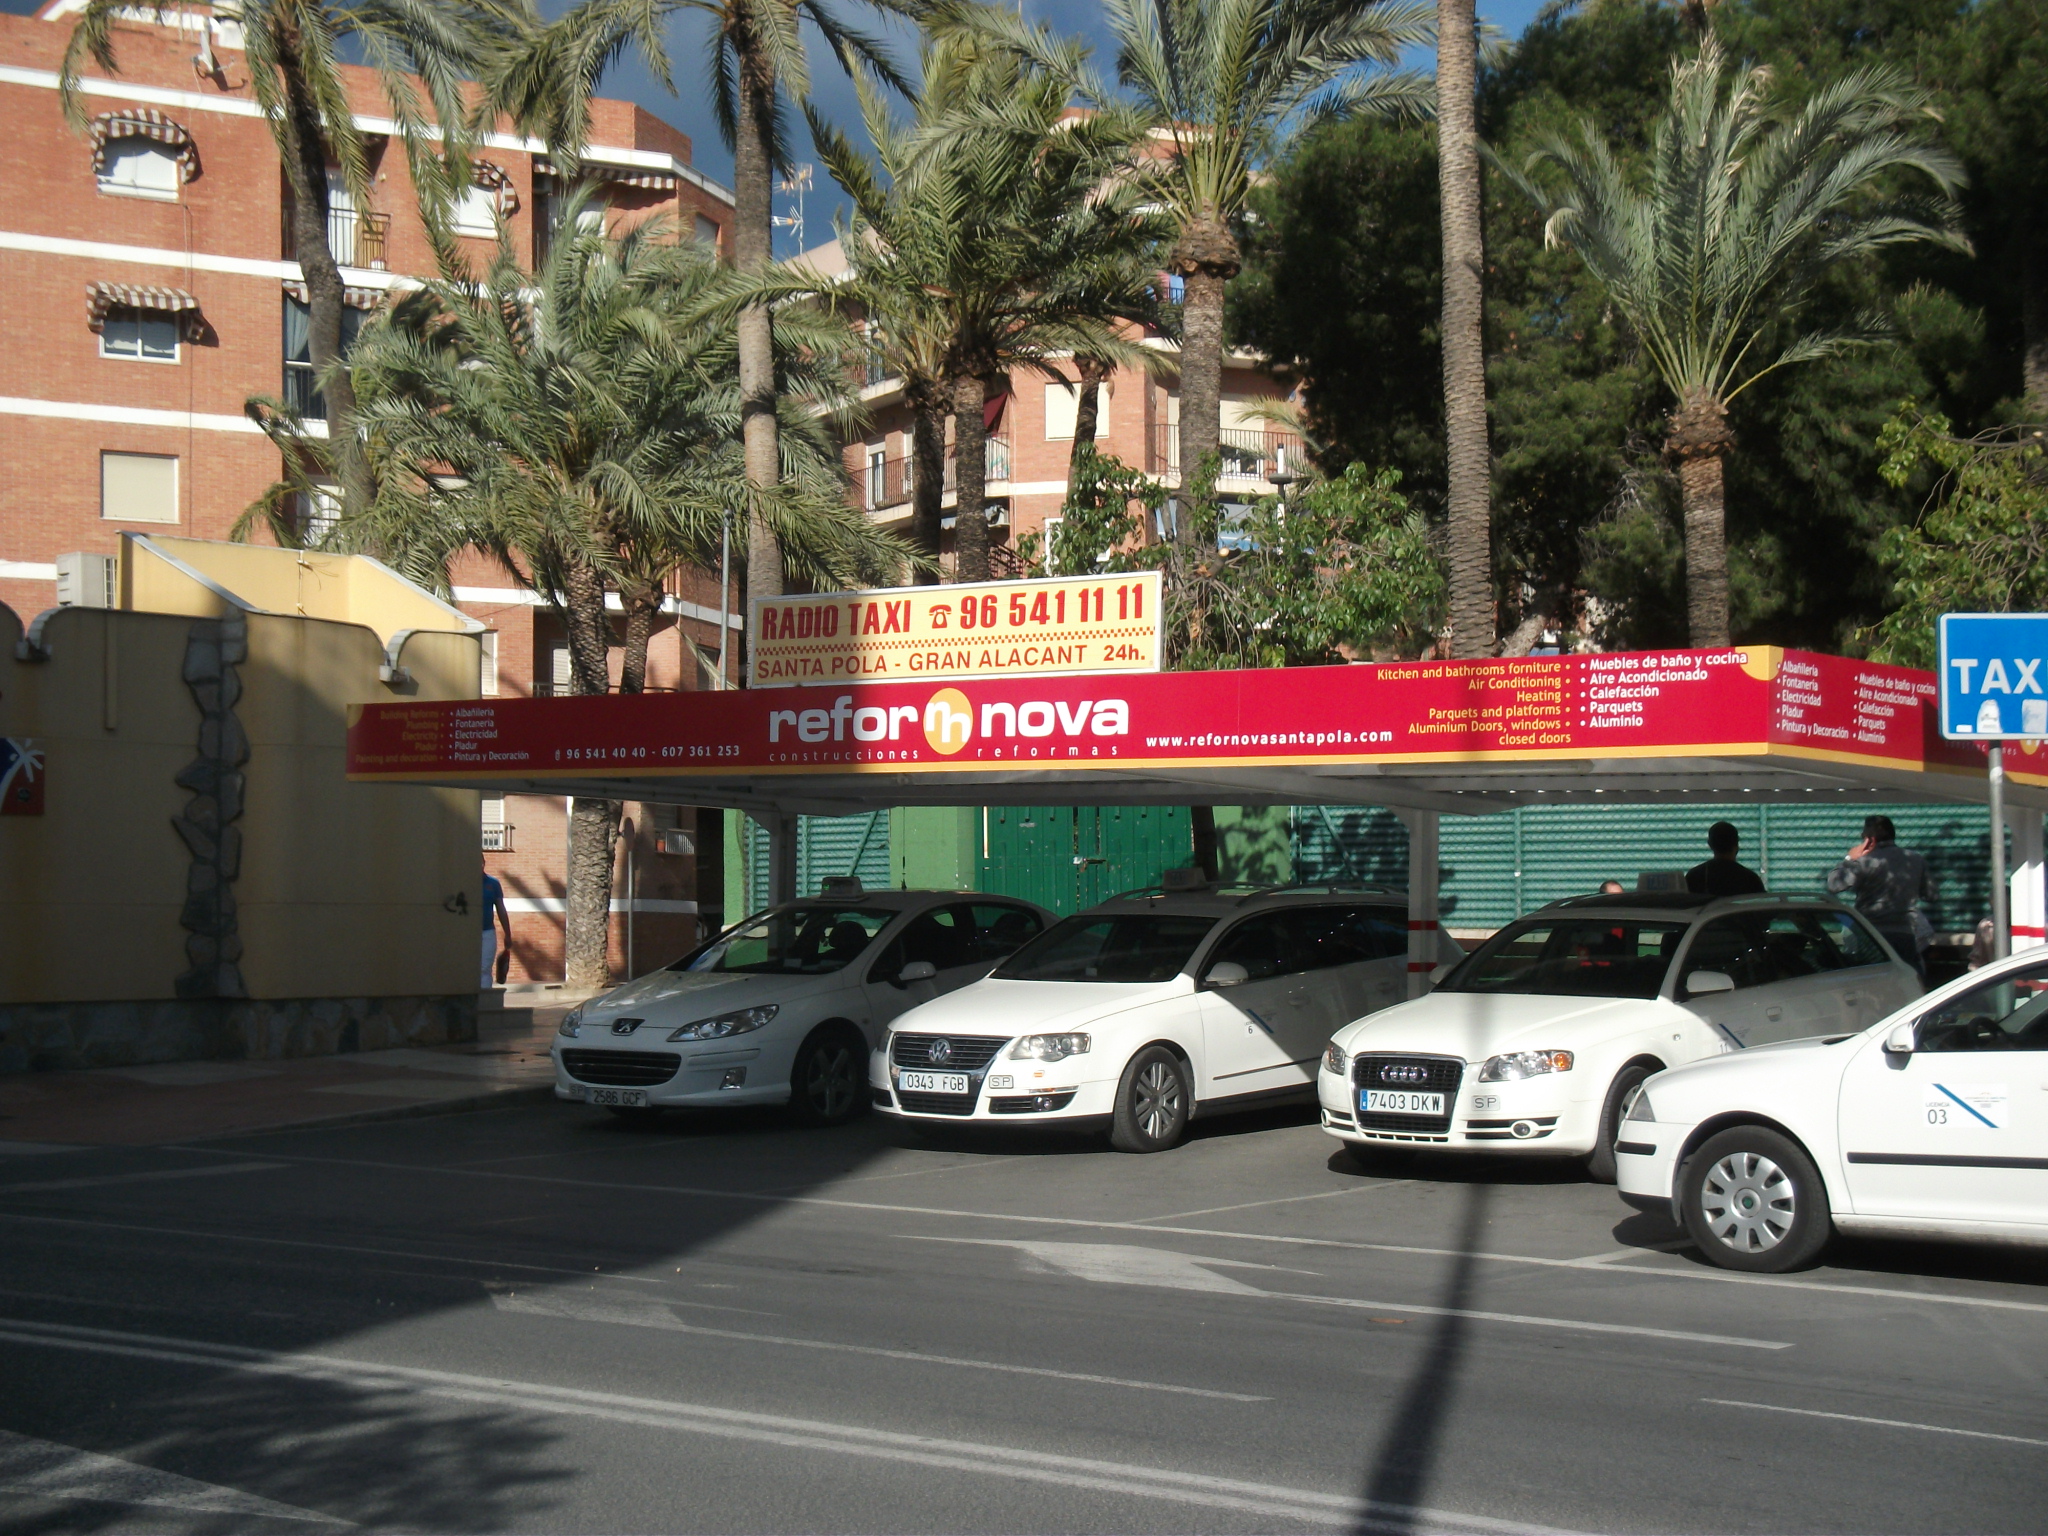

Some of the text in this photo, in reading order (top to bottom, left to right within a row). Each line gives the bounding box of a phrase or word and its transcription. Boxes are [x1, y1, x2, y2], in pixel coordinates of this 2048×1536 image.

[762, 583, 1143, 641] RADIO TAXI 96 541 11 11
[758, 658, 824, 678] SANTA
[831, 655, 887, 675] POLA
[909, 651, 970, 671] GRAN
[979, 645, 1087, 668] ALACANT
[1103, 644, 1146, 662] 24h.
[1590, 650, 1748, 671] Muebles de baño y cocina
[1377, 661, 1561, 681] Kitchen and bathrooms forniture
[1589, 668, 1708, 685] Aire Acondicionado
[1782, 661, 1818, 678] Albañilería
[1950, 658, 2048, 695] TAX
[1468, 675, 1561, 693] Air Conditioning
[1589, 684, 1659, 700] Calefacción
[1782, 676, 1818, 692] Fontanería
[1859, 673, 1936, 695] Muebles de baño y cocina
[1516, 689, 1561, 705] Heating
[1782, 691, 1822, 706] Electricidad
[1859, 688, 1918, 706] Aire Acondicionado
[1429, 702, 1561, 722] Parquets and platforms
[1590, 699, 1643, 716] Parquets
[1781, 705, 1803, 719] Pladur
[1858, 701, 1894, 717] Calefacción
[1408, 717, 1561, 734] Aluminium Doors, windows
[1589, 714, 1643, 728] Aluminio
[1858, 715, 1886, 731] Parquets
[455, 729, 498, 739] Electricidad
[1781, 720, 1849, 739] Pintura y Decoración
[1857, 729, 1886, 744] Aluminio
[454, 741, 478, 750] Pladur
[1146, 729, 1393, 748] www.refornovasantapola.com
[1499, 731, 1571, 746] closed doors
[454, 751, 529, 763] Pintura y Decoración
[566, 748, 580, 759] 96
[585, 747, 606, 759] 541
[612, 747, 626, 758] 40
[631, 746, 646, 758] 40
[661, 746, 684, 757] 607
[689, 745, 711, 757] 361
[717, 745, 740, 756] 253
[769, 745, 1118, 762] construcciones reformas
[1248, 1025, 1253, 1034] 6
[907, 1074, 965, 1091] 0343 FGB
[992, 1077, 1011, 1087] SP
[594, 1090, 641, 1105] 2586 GCF
[1370, 1093, 1440, 1111] 7403 DKW
[1474, 1097, 1497, 1108] SP
[1927, 1109, 1947, 1124] 03
